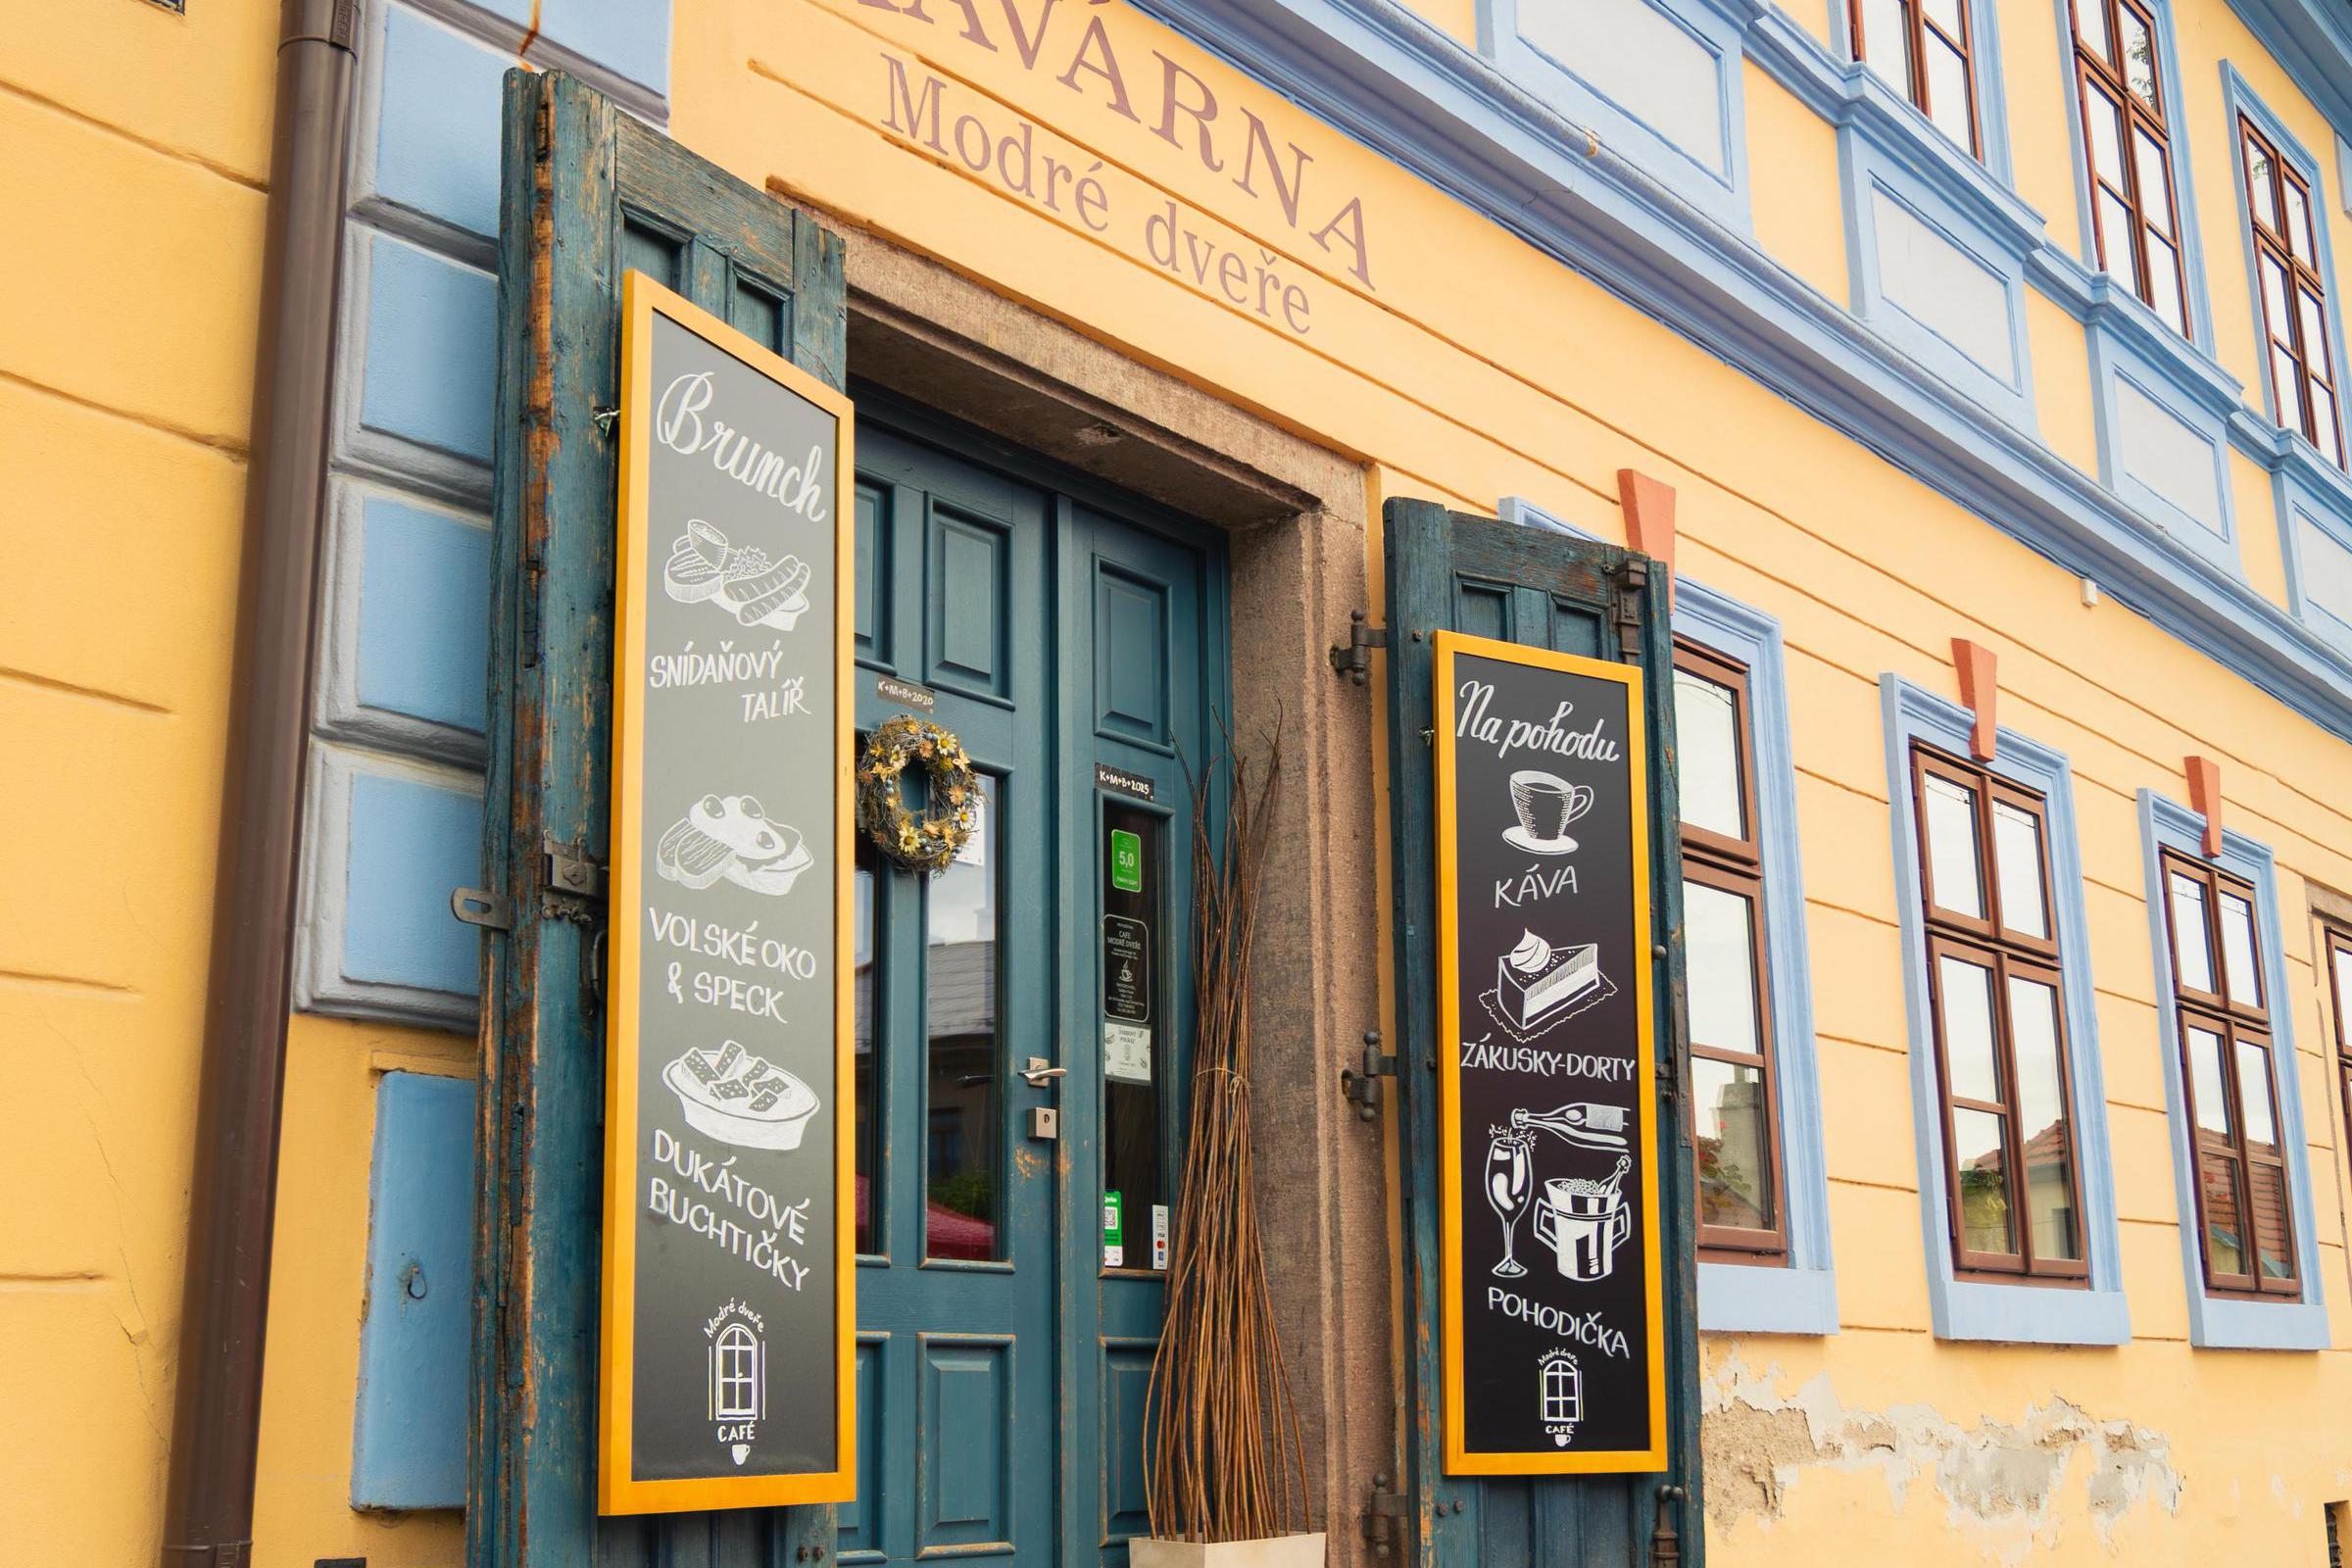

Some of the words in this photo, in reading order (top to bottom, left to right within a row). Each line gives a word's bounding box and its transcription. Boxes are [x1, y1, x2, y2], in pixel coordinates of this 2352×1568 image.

[857, 0, 1376, 291] VÁRNA
[880, 52, 1109, 232] Modré
[1145, 202, 1312, 334] dveře
[657, 371, 827, 522] Brunch
[650, 640, 783, 688] SNÍDAŇOVÝ
[742, 675, 811, 723] TALÍŘ
[1457, 680, 1499, 744] Na
[1498, 701, 1620, 761] pohodu
[1118, 851, 1135, 867] 5,0
[1494, 863, 1579, 909] KÁVA
[649, 907, 758, 966] VOLSKÉ
[760, 939, 816, 980] OKO
[667, 961, 684, 1004] &
[694, 971, 788, 1024] SPECK
[1460, 1033, 1637, 1083] ZÁKUSKY-DORTY
[654, 1129, 810, 1245] DUKÁTOVÉ
[649, 1177, 810, 1292] BUCHTIČKY
[704, 1297, 737, 1339] Modré
[737, 1300, 765, 1333] dveře
[1488, 1286, 1631, 1359] POHODIČKA
[716, 1421, 757, 1443] CAFÉ
[1544, 1422, 1575, 1435] CAFÉ
